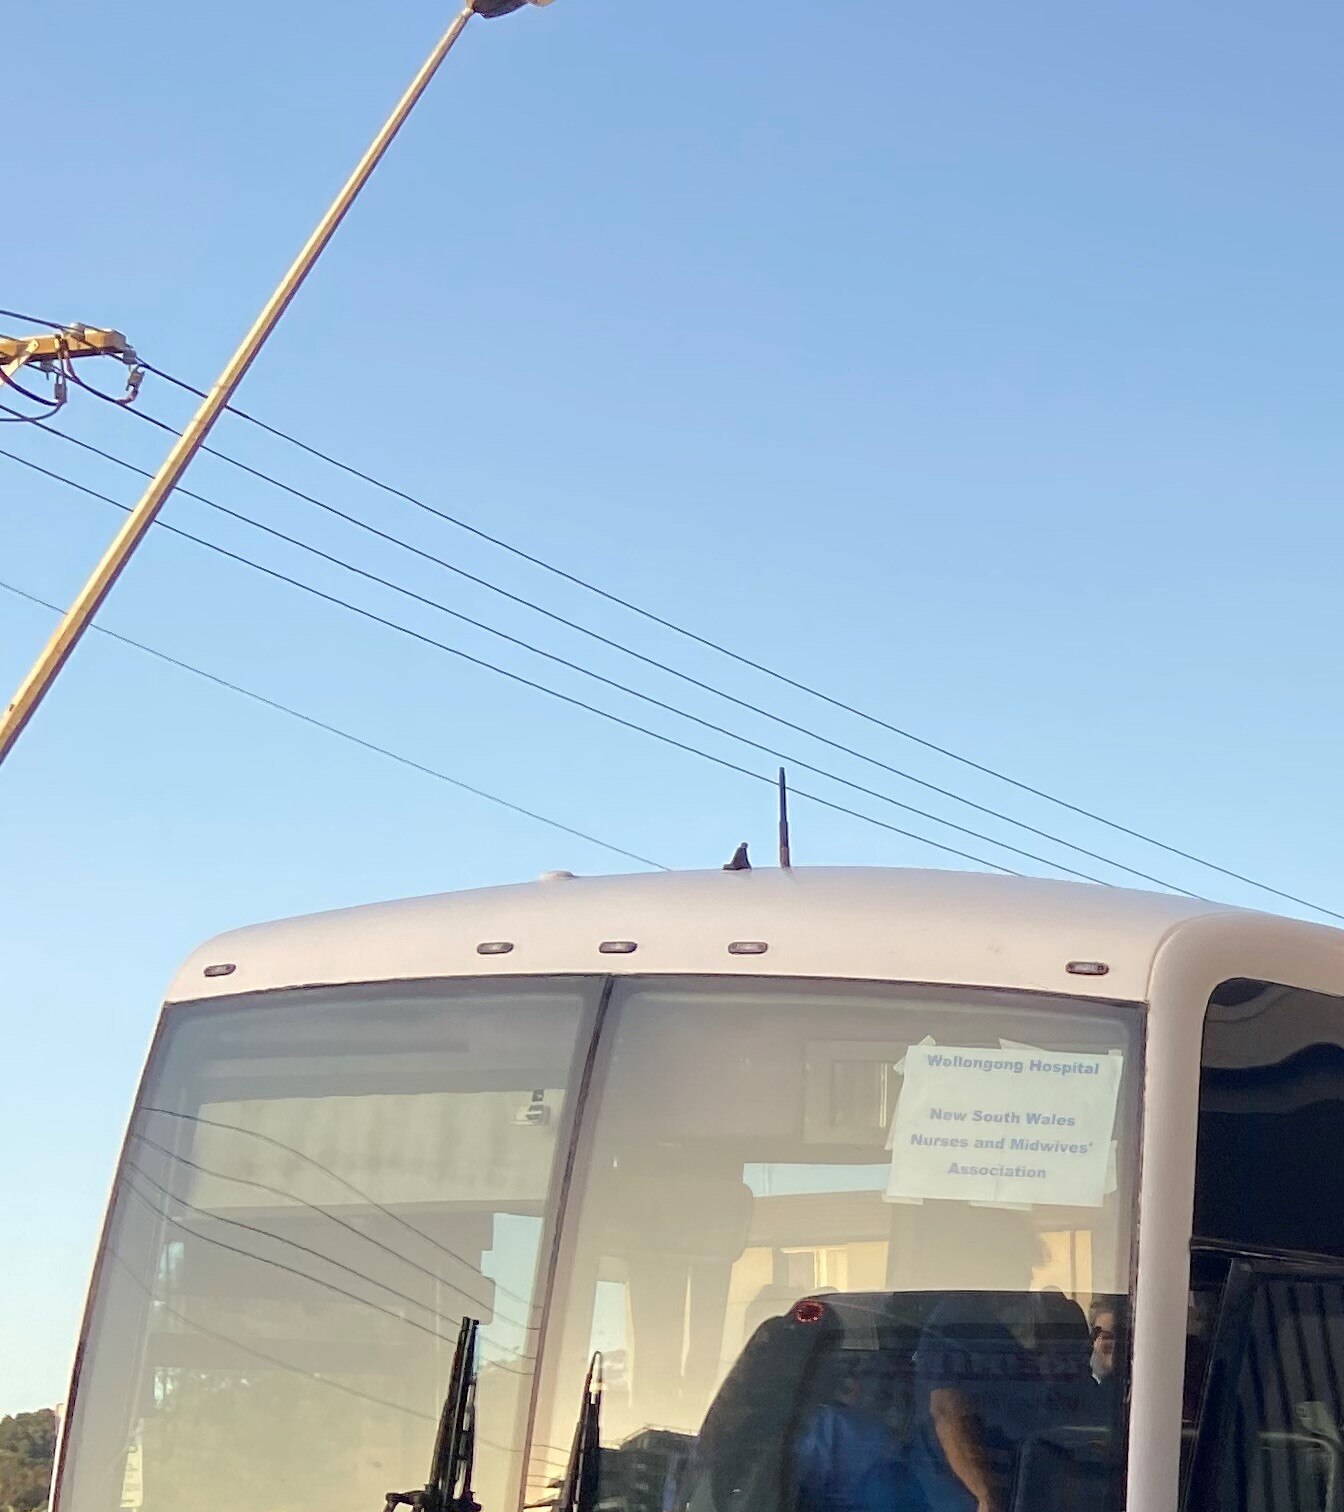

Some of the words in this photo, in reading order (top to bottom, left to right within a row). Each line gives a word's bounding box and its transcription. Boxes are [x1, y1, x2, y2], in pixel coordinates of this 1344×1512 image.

[927, 1054, 1024, 1073] Wollongong
[1029, 1059, 1100, 1076] Hospital
[930, 1107, 968, 1122] New
[972, 1110, 1021, 1124] South
[1026, 1112, 1076, 1127] Wales
[910, 1133, 969, 1148] Nurses
[974, 1136, 1005, 1150] and
[947, 1162, 1047, 1179] Association
